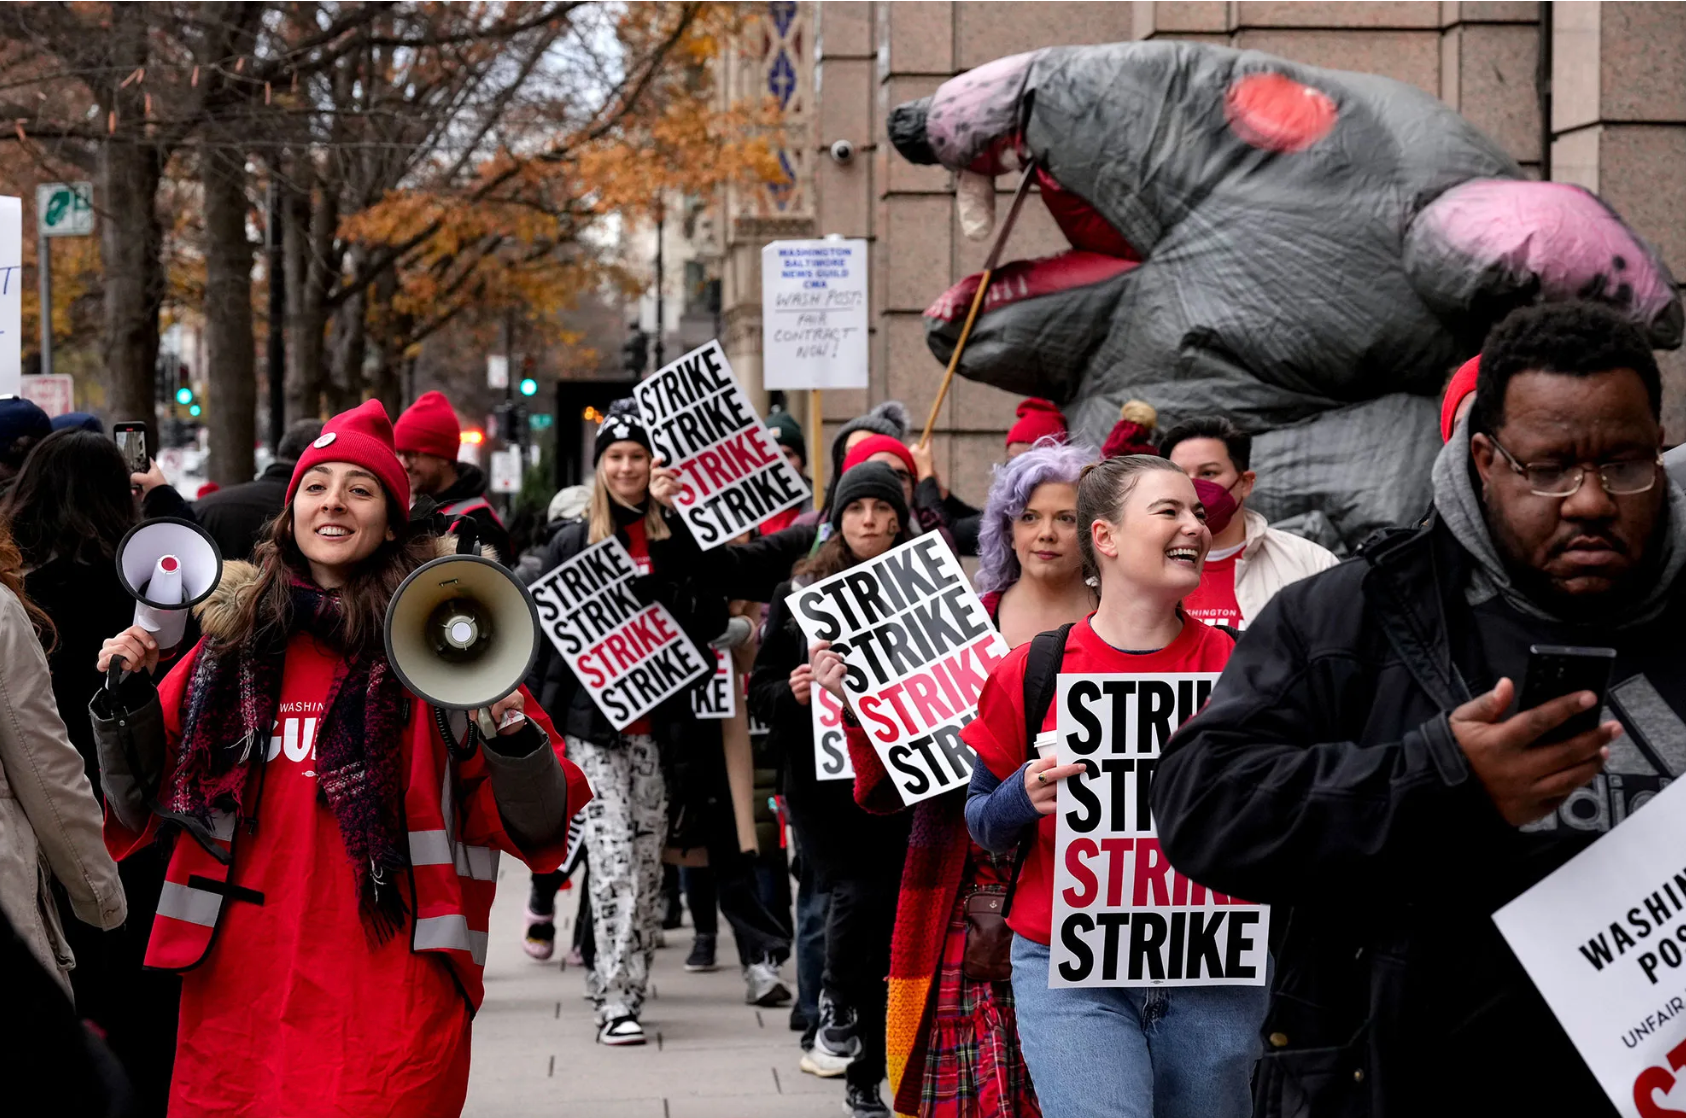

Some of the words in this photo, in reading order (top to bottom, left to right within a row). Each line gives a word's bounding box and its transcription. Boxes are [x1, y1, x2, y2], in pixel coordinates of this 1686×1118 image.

[778, 249, 852, 257] WASHINGTON
[781, 270, 812, 278] NEWS
[815, 270, 848, 278] GUILD
[784, 259, 845, 267] BALTIMORE
[773, 327, 859, 342] CONTRACT
[775, 292, 820, 307] WASH
[797, 311, 827, 326] FAIR
[640, 346, 732, 426] STRIKE
[652, 386, 755, 467] STRIKE
[671, 425, 779, 505] STRIKE
[688, 462, 803, 542] STRIKE
[531, 541, 632, 622] STRIKE
[799, 537, 960, 642] STRIKE
[577, 606, 679, 689] STRIKE
[829, 585, 989, 694] STRIKE
[601, 638, 700, 722] STRIKE
[1066, 680, 1212, 755] STRI
[888, 711, 977, 795] STR
[1062, 838, 1261, 908] STR
[1057, 911, 1260, 982] STRIKE
[1621, 996, 1685, 1049] UNFAIR
